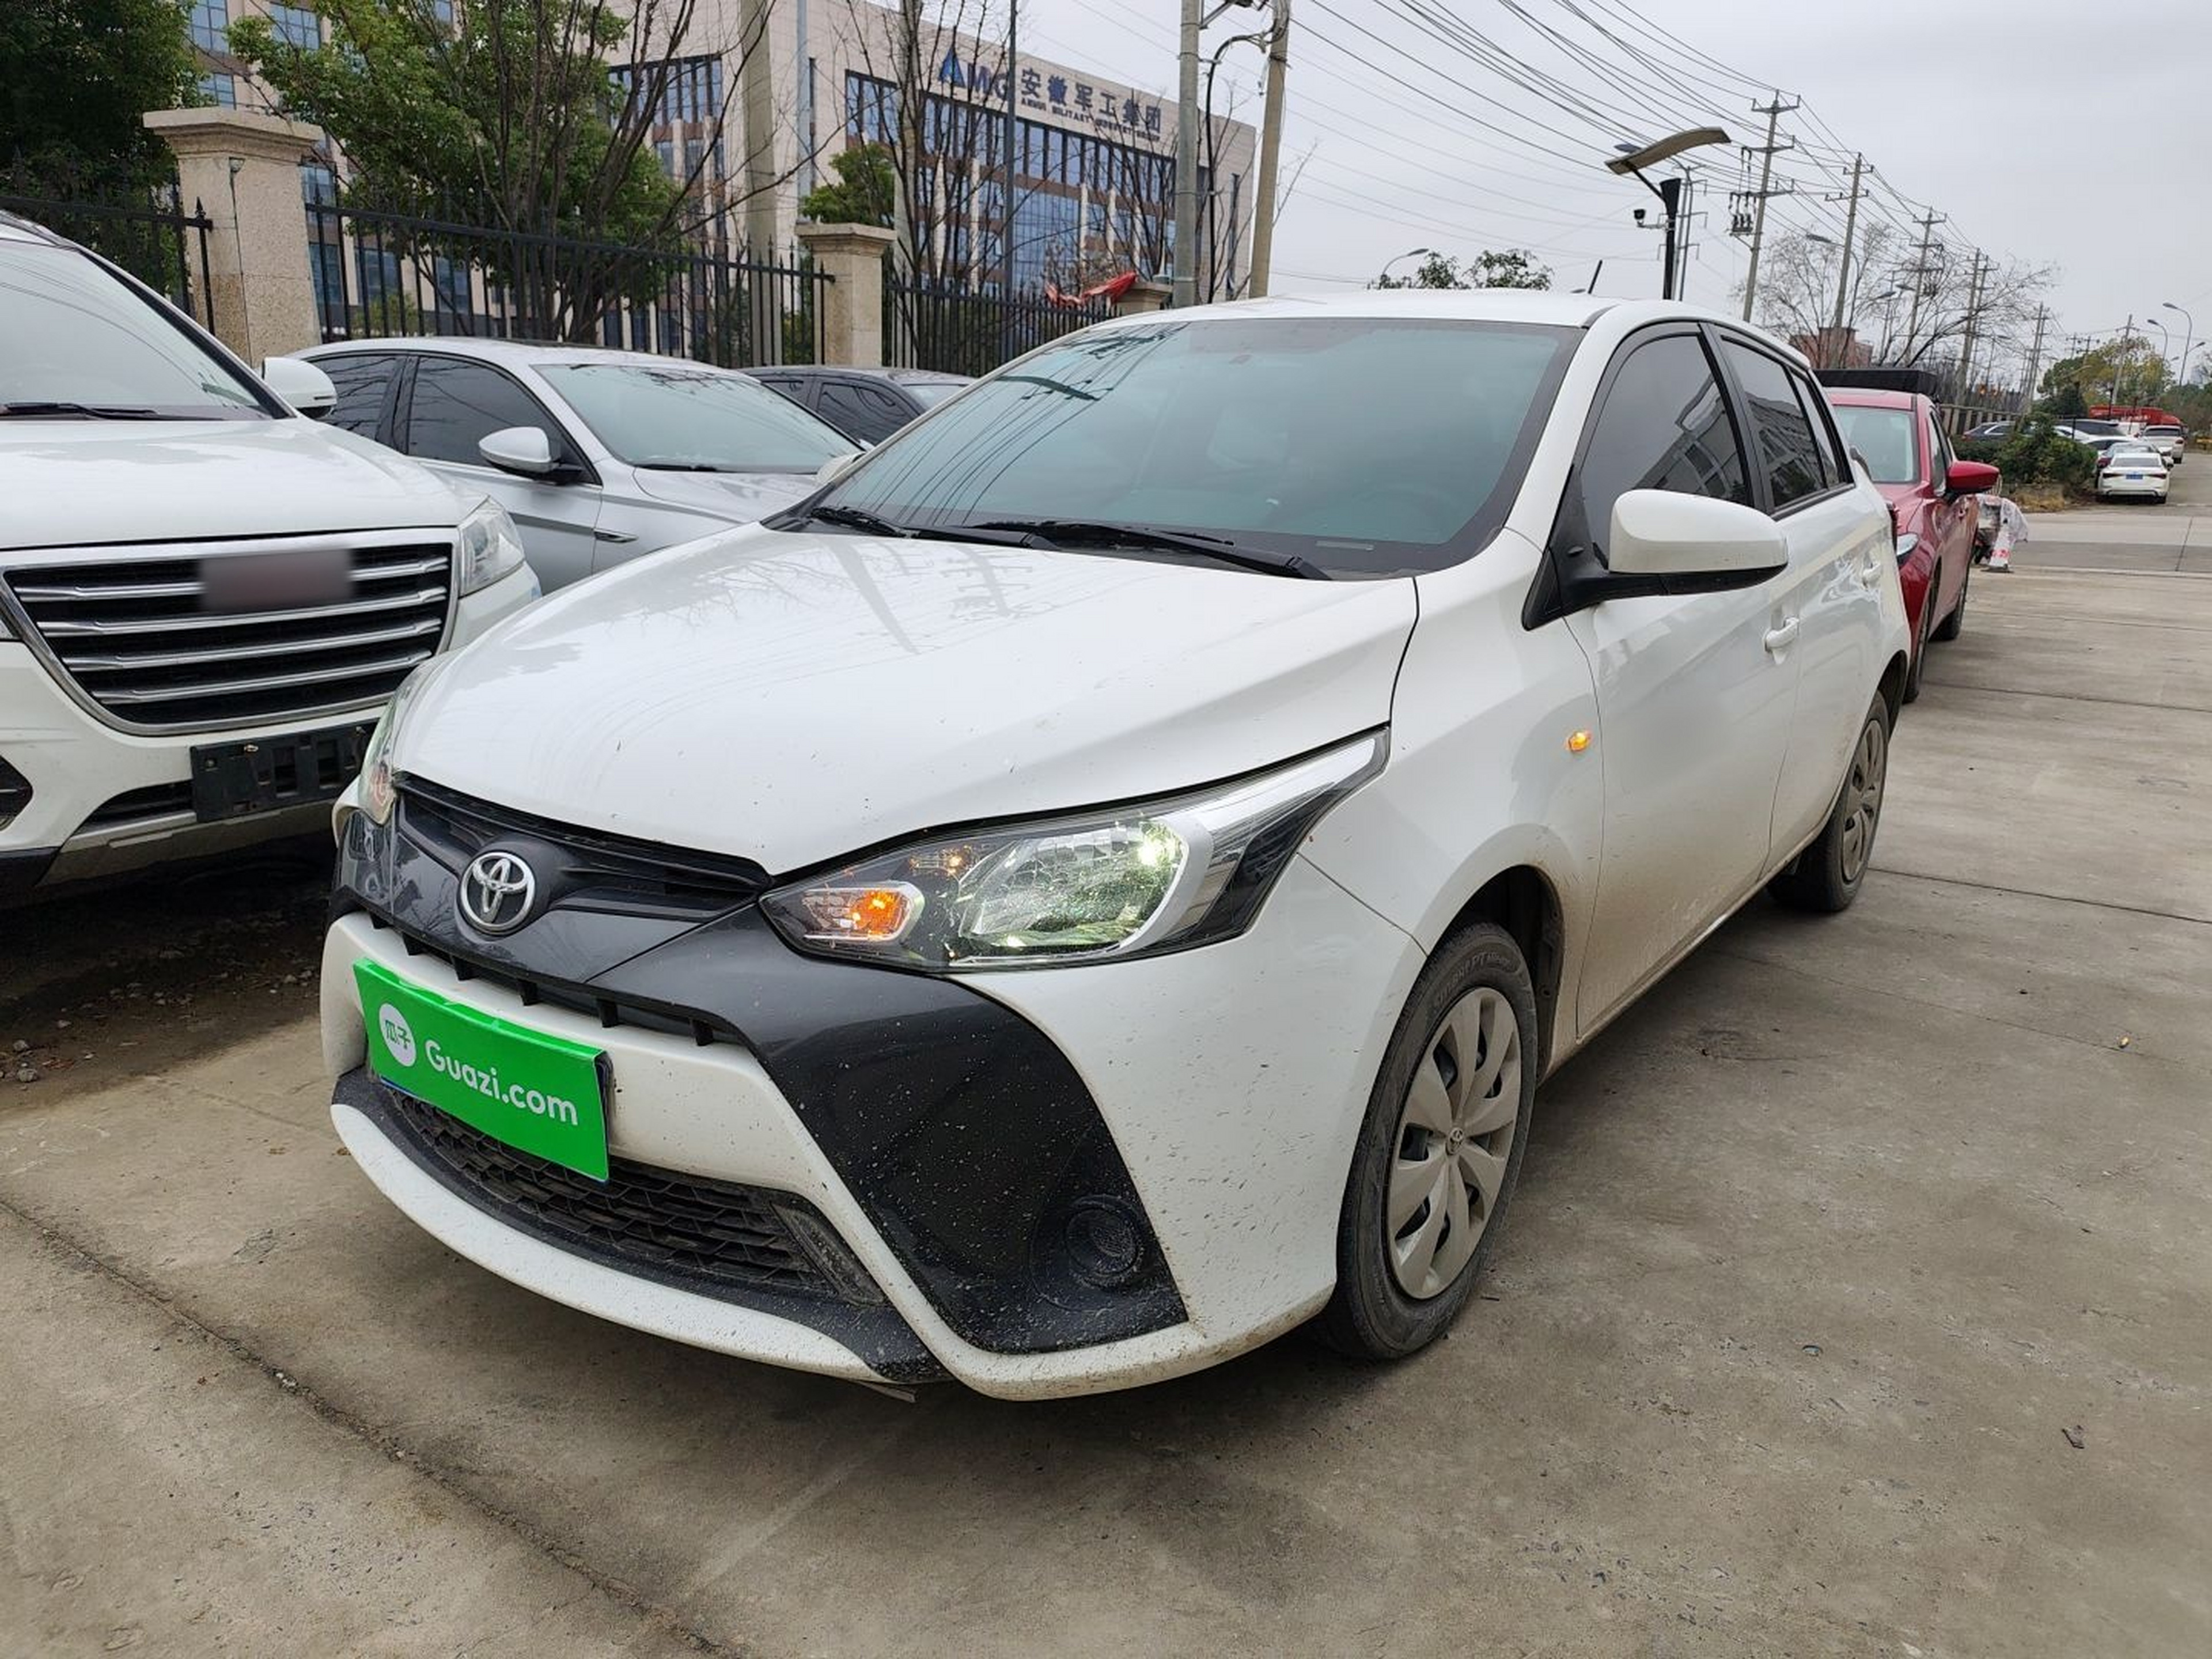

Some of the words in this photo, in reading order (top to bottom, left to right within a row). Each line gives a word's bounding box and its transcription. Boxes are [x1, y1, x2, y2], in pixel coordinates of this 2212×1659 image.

[1021, 67, 1161, 133] 安徽军工集团
[385, 1019, 411, 1050] 瓜子
[425, 1039, 578, 1126] Guazi.com
